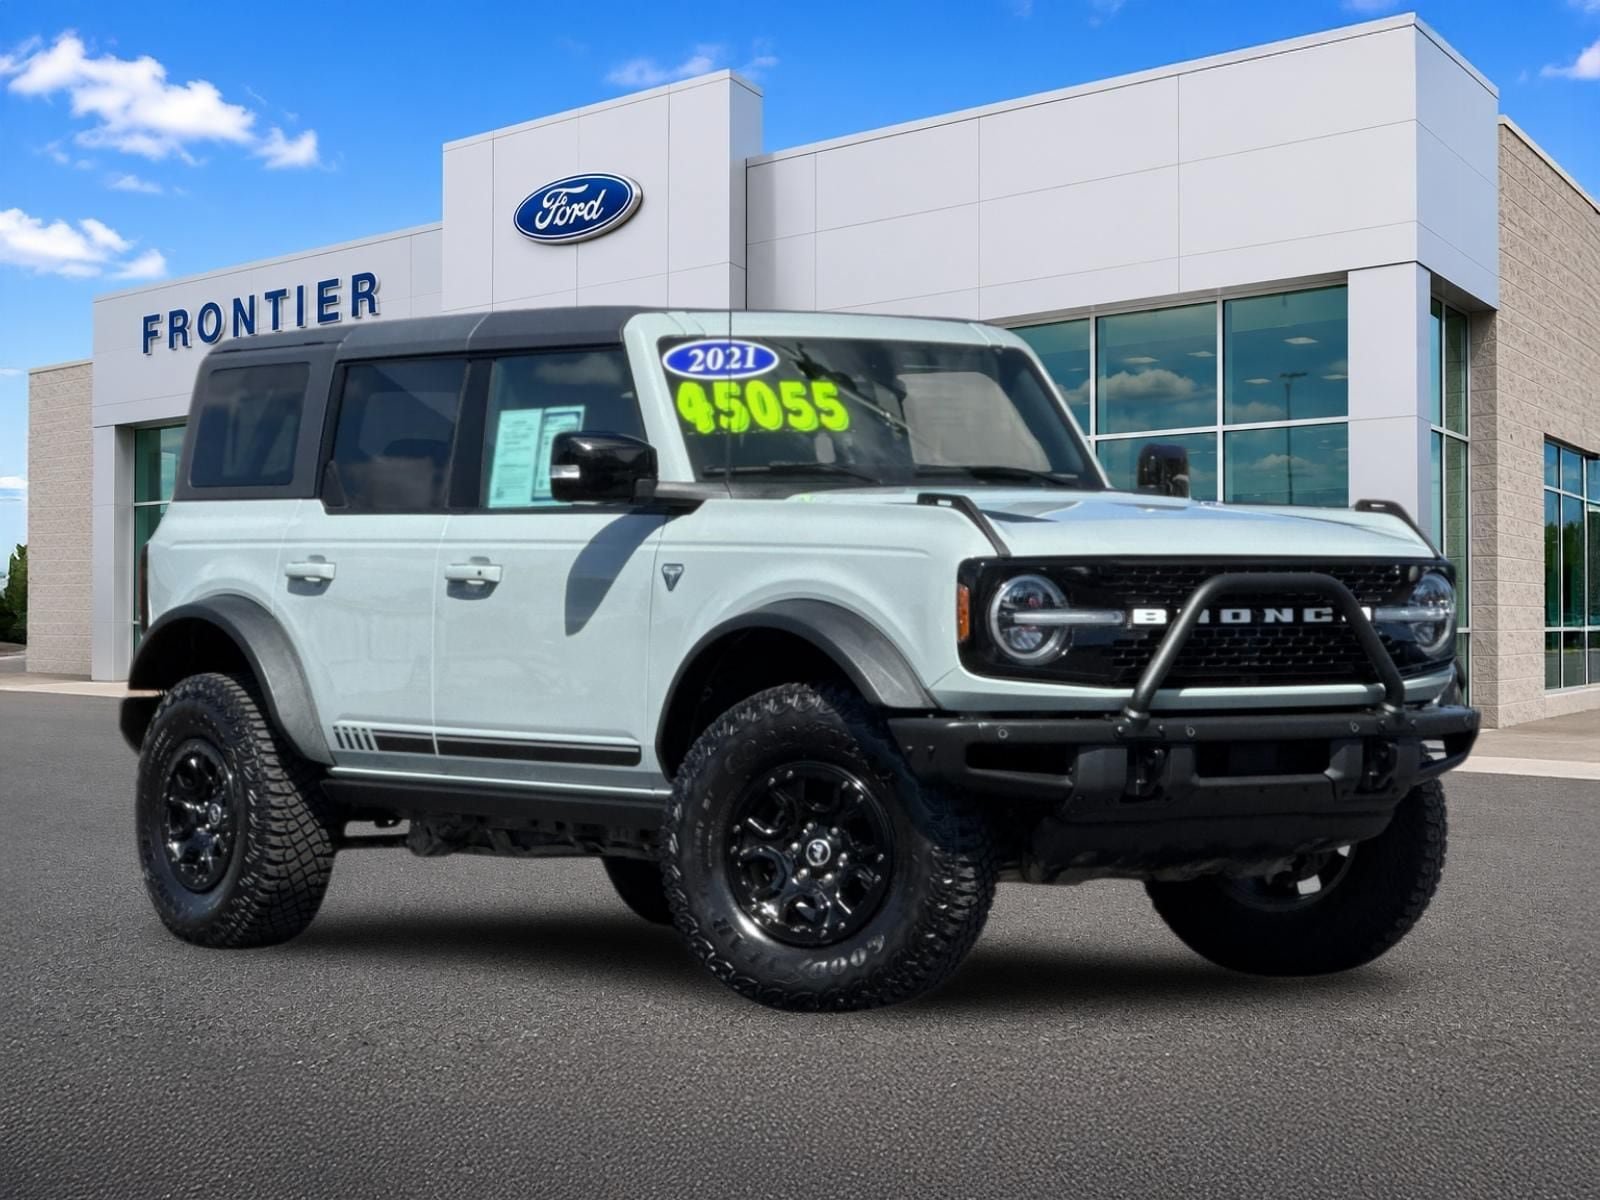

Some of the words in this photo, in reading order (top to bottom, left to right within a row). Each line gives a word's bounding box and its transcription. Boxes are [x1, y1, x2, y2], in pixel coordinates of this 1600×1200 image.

[535, 185, 606, 229] Ford
[142, 272, 380, 354] FRONTIER
[688, 346, 757, 372] 2021
[678, 380, 849, 433] 45055
